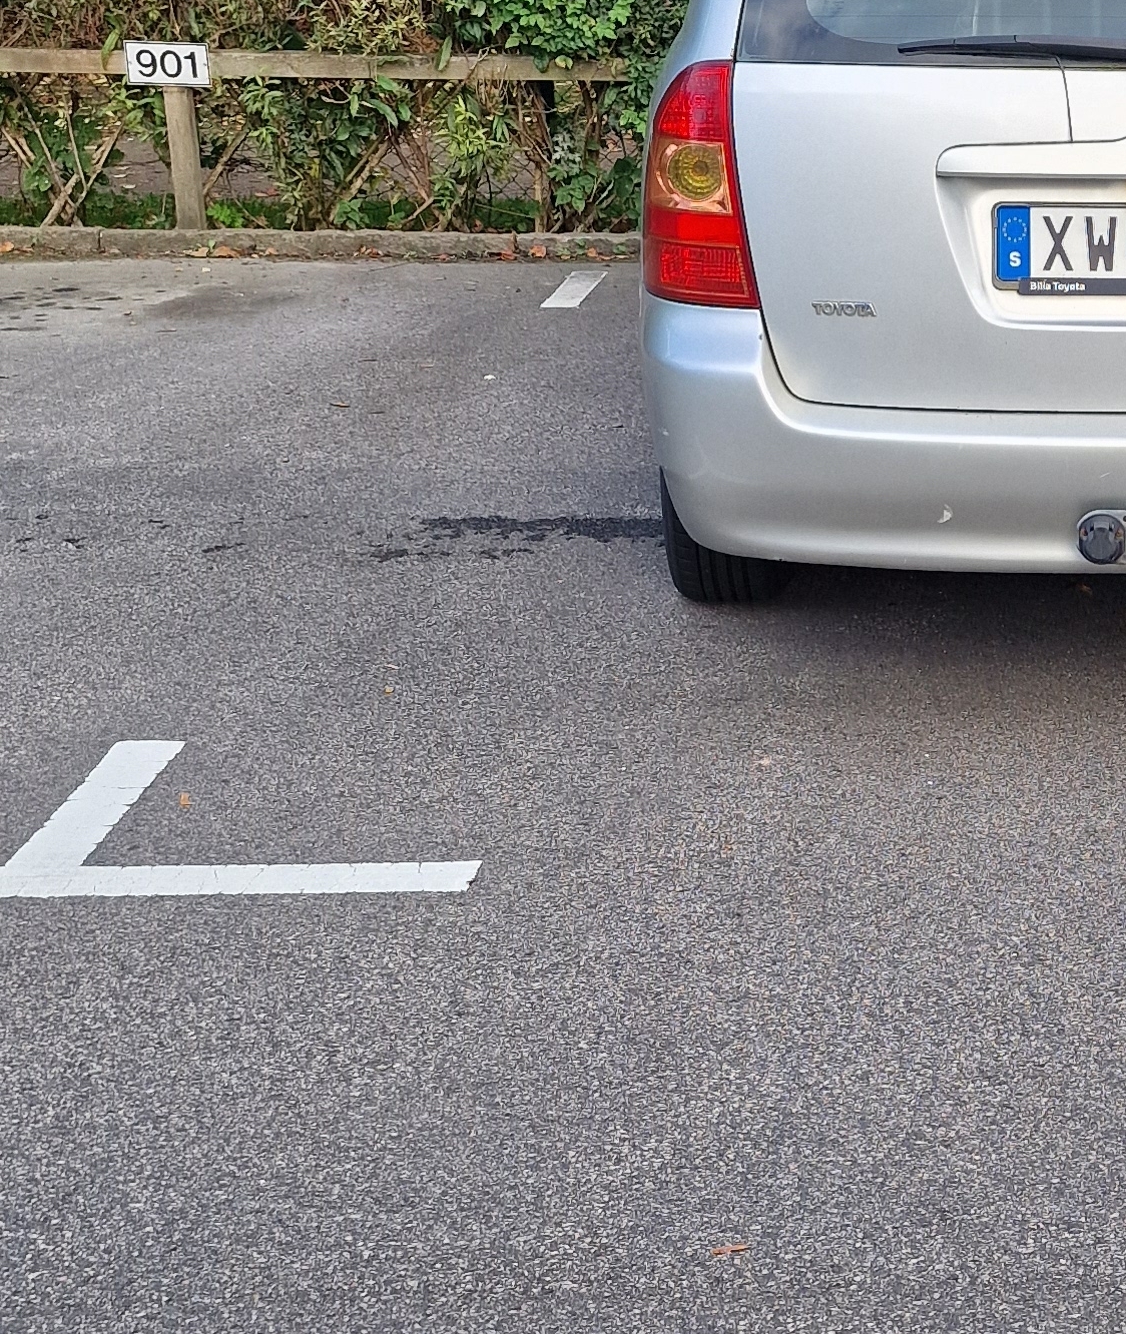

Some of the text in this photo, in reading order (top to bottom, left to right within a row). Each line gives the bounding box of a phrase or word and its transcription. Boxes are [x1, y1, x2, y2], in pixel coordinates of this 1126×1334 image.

[136, 49, 198, 78] 901
[1009, 251, 1021, 267] S
[1030, 279, 1086, 293] Bilia Toyota
[811, 300, 877, 317] TOYOTA
